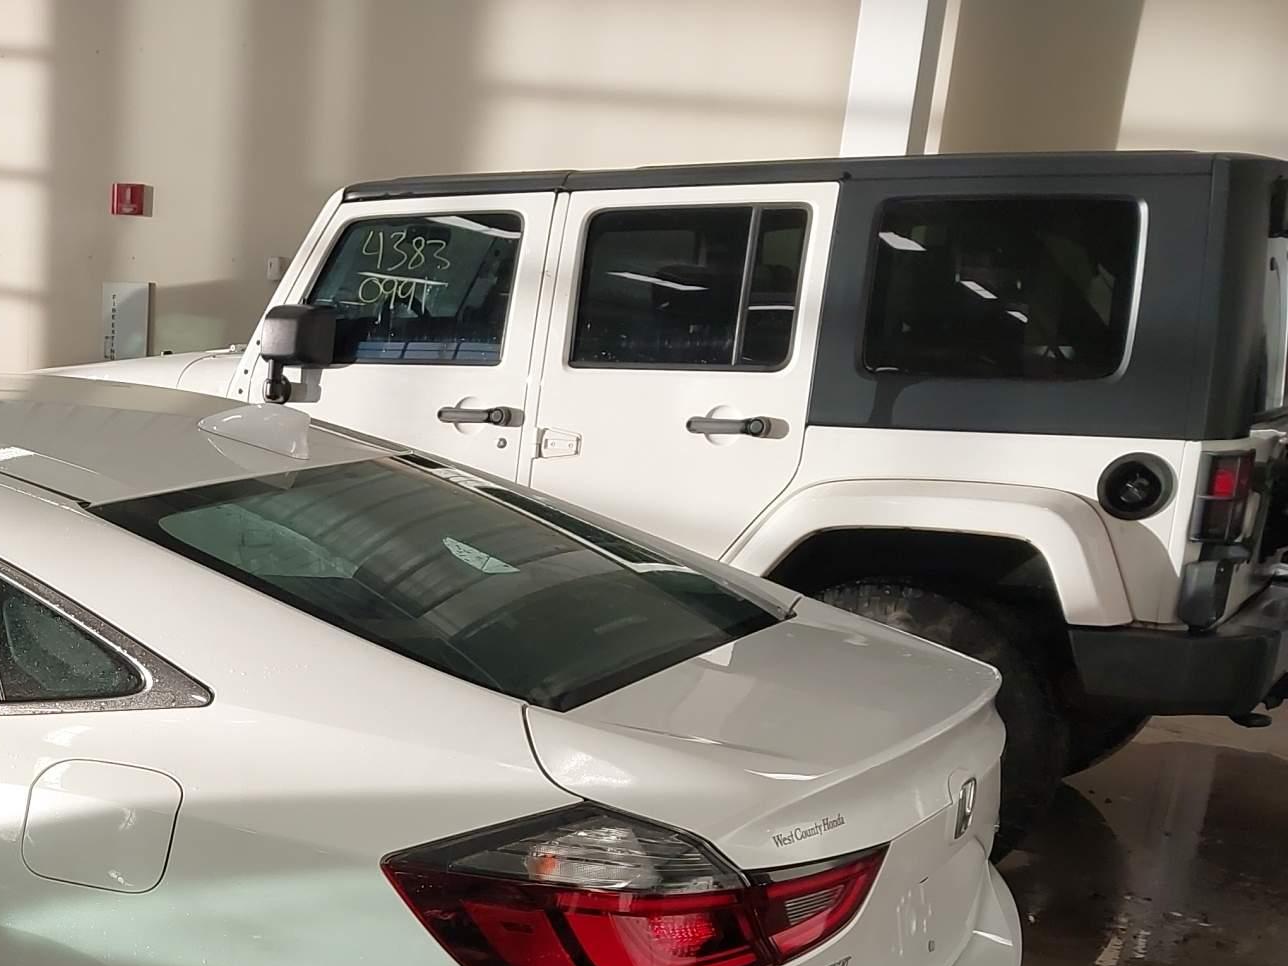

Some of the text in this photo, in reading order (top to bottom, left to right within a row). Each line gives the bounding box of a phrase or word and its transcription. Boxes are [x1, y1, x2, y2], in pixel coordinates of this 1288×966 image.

[362, 228, 451, 272] 4383
[358, 276, 428, 315] 0991
[772, 813, 846, 848] West County Honda
